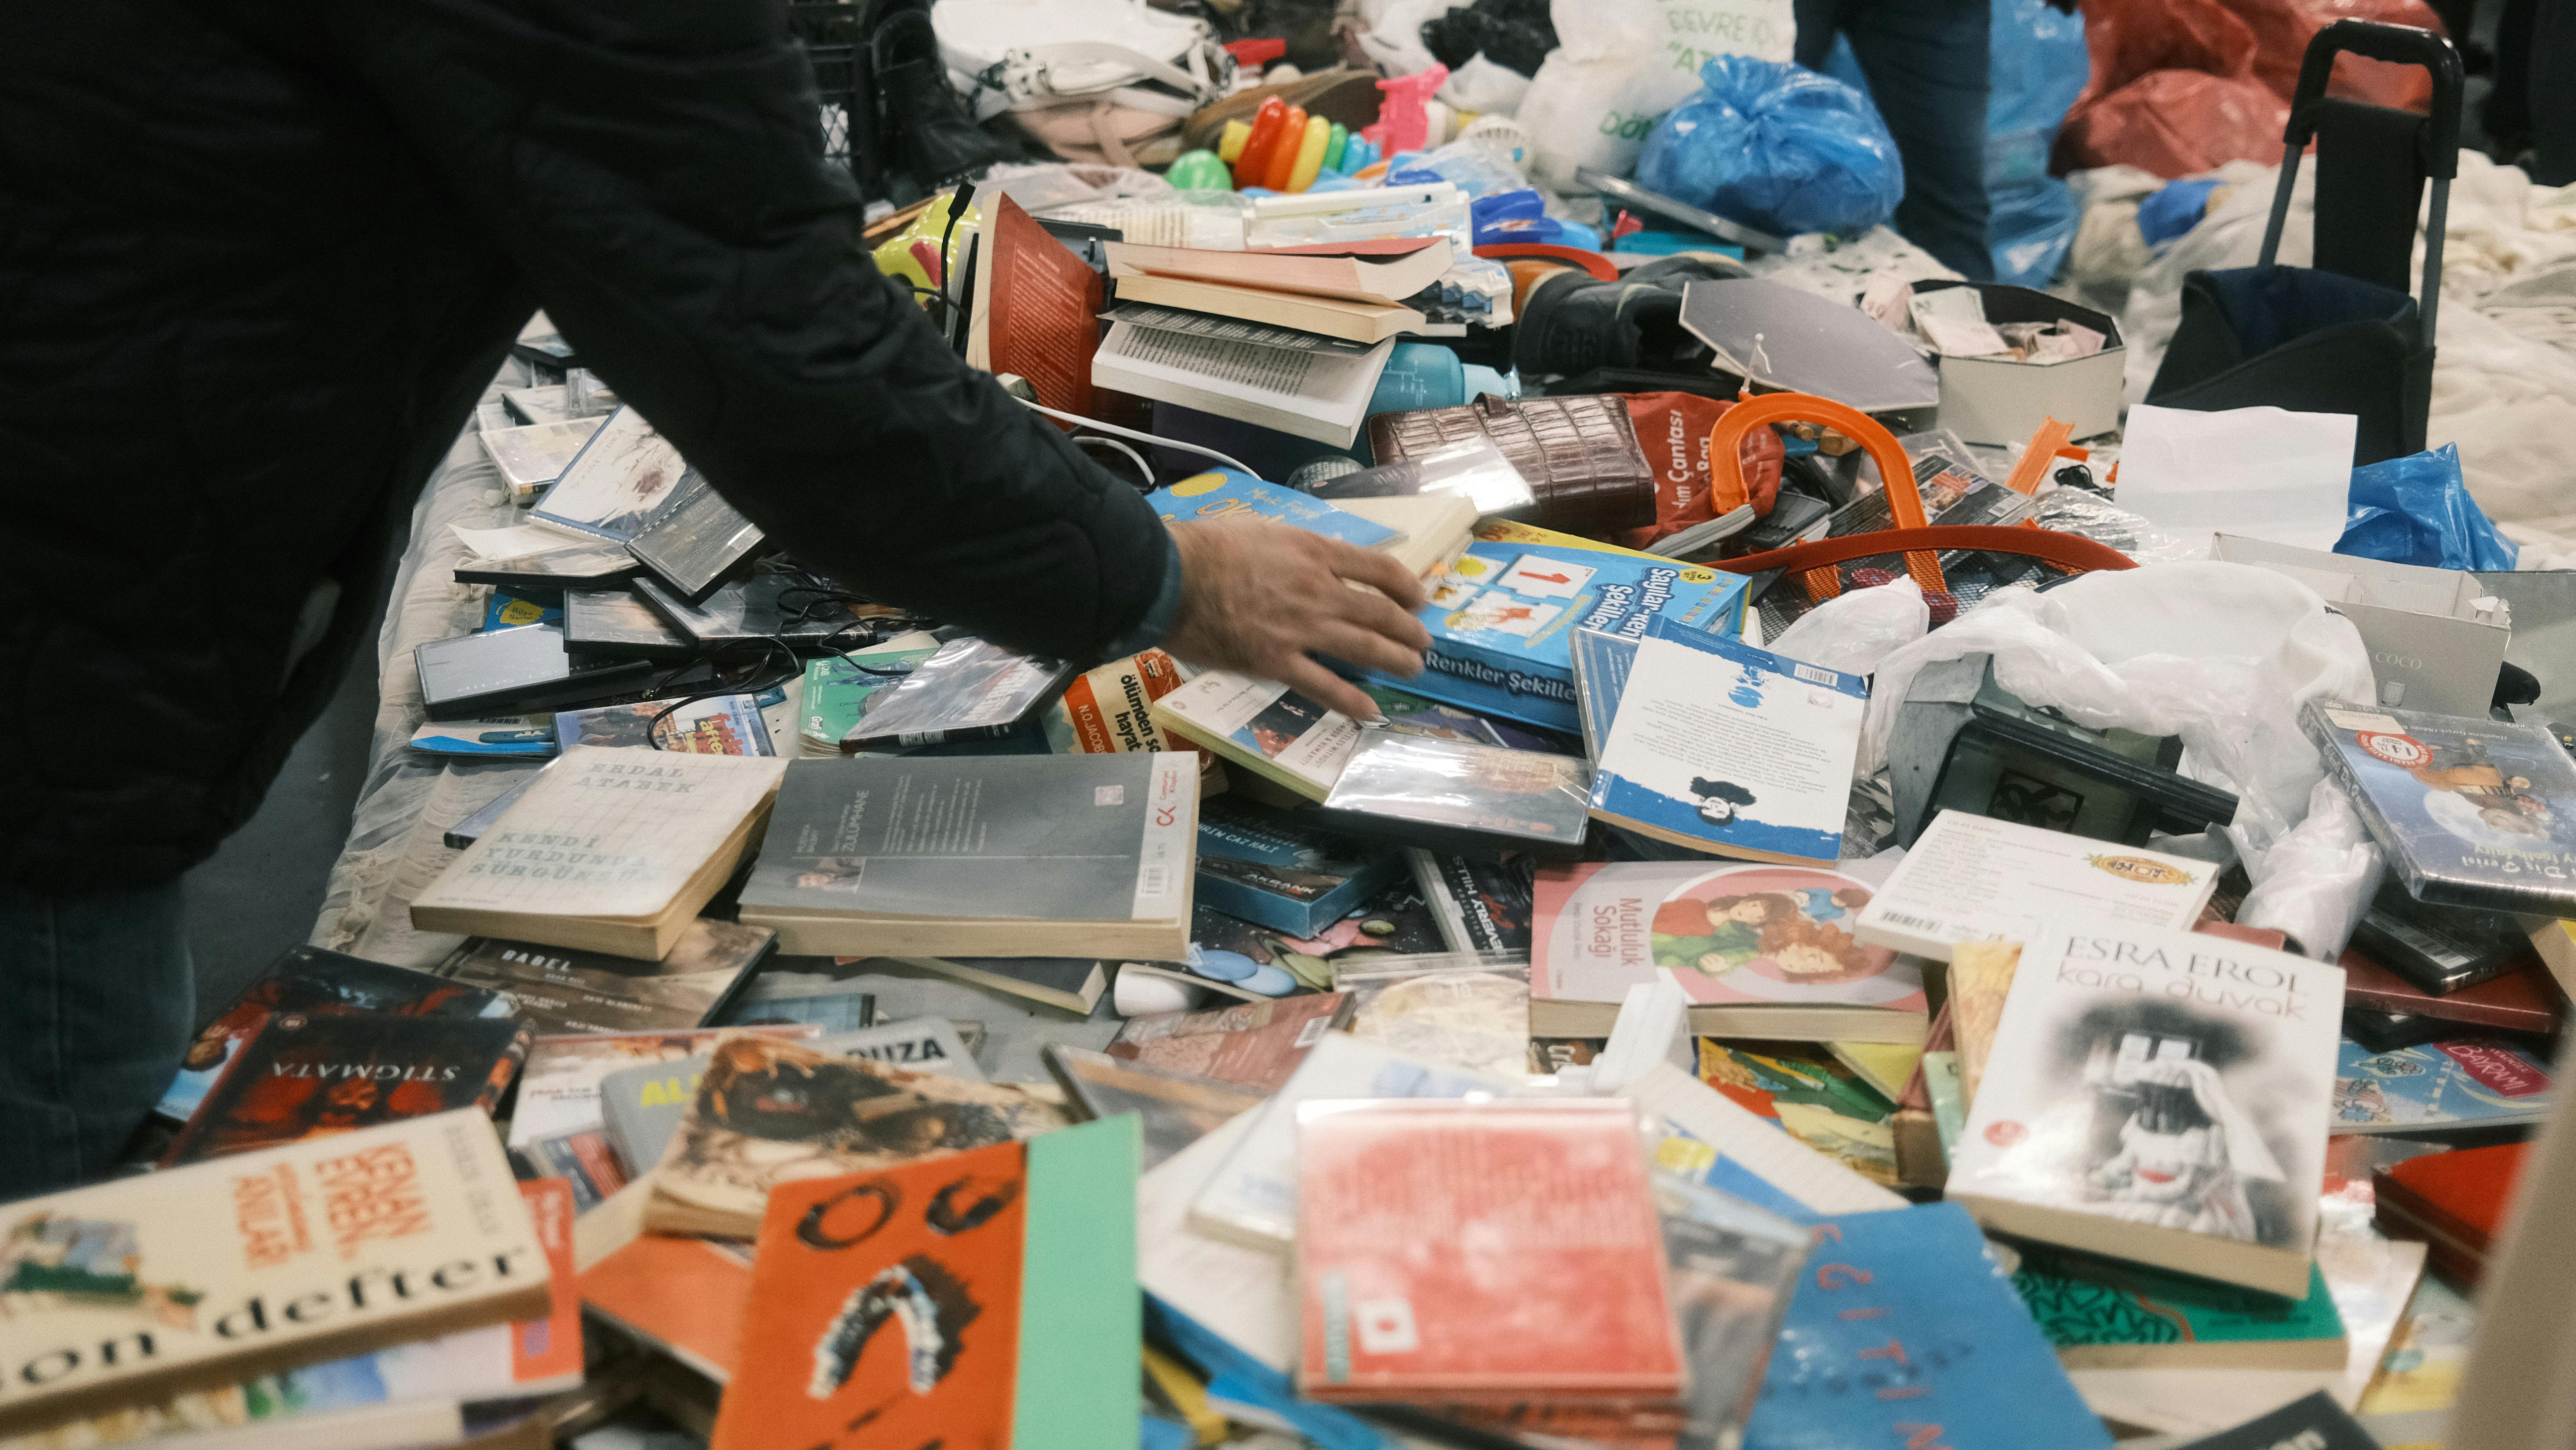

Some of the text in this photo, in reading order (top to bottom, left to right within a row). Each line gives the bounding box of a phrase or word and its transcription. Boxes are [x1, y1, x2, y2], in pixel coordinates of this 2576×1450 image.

[1666, 409, 1695, 482] Çantası
[1697, 571, 1712, 583] 3
[512, 607, 533, 616] Rüya
[1584, 583, 1633, 632] Şekiller
[1425, 651, 1505, 683] Renkler
[2375, 653, 2422, 671] COCO
[708, 711, 744, 756] frida
[1115, 709, 1144, 753] hayat
[1120, 671, 1162, 753] ölümden so
[573, 775, 698, 794] ATABEK
[586, 761, 686, 778] ERDAL
[498, 831, 601, 849] KENDİ
[1225, 833, 1250, 846] CAZ
[1248, 839, 1279, 854] HALİ
[1451, 854, 1478, 897] HILLS
[1588, 904, 1617, 958] Sokağı
[1619, 896, 1646, 966] Mutluluk
[501, 948, 572, 973] BABEL
[2065, 936, 2310, 999] ESRA EROL
[2055, 961, 2307, 1021] kara duvak
[272, 1061, 461, 1082] STIGMATA
[2447, 1045, 2530, 1090] BAYRAMI
[0, 1244, 530, 1388] on defter
